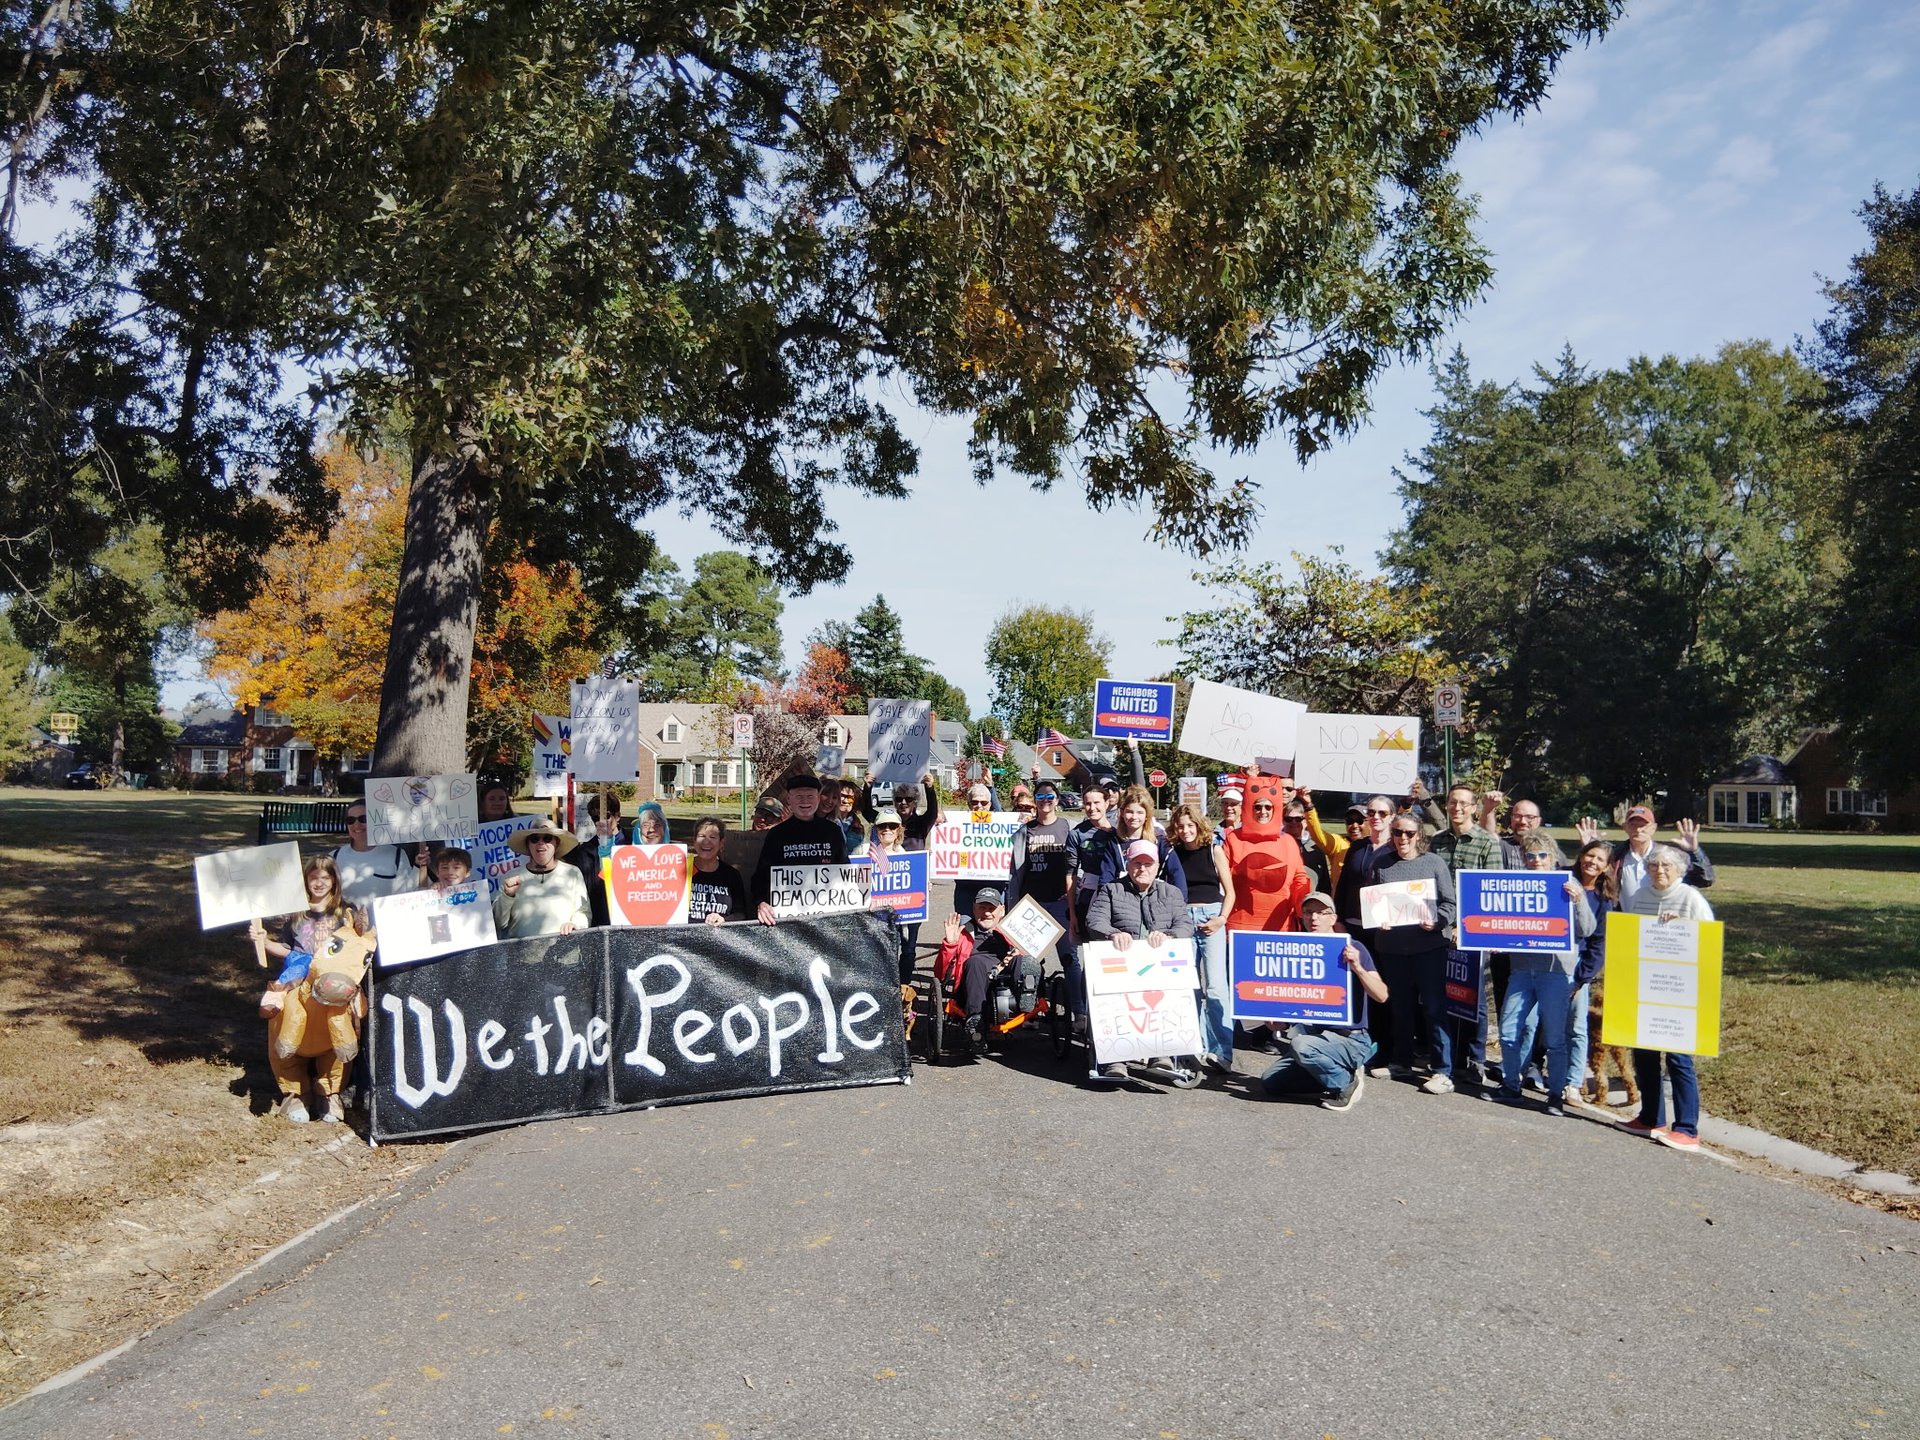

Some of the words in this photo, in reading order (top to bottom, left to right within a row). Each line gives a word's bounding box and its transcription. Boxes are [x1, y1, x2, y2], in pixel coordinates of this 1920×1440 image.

[1112, 686, 1158, 698] NEIGHBORS
[876, 705, 904, 719] SAVE
[1111, 696, 1158, 713] UNITED
[1117, 716, 1157, 726] DEMOCRACY
[1221, 700, 1253, 730] NO
[871, 722, 927, 736] DEMOCRACY
[889, 740, 904, 750] NO
[1207, 727, 1278, 764] KINGS
[1319, 725, 1359, 750] NO
[542, 753, 566, 769] THE
[1150, 774, 1166, 783] STOP
[1319, 758, 1409, 785] KINGS
[410, 804, 468, 824] SHALL
[936, 827, 961, 844] NO
[1030, 835, 1055, 844] PROUD
[619, 856, 637, 869] WE
[654, 853, 683, 866] LOVE
[783, 850, 832, 858] PATRIOTIC
[935, 851, 960, 869] NO
[627, 869, 678, 882] AMERICA
[772, 868, 804, 887] THIS
[815, 868, 830, 885] IS
[840, 867, 871, 884] WHAT
[644, 882, 662, 890] AND
[1480, 879, 1547, 892] NEIGHBORS
[627, 890, 678, 903] FREEDOM
[710, 893, 716, 902] A
[771, 888, 869, 908] DEMOCRACY
[1480, 892, 1548, 913] UNITED
[1022, 907, 1051, 934] DEI
[1491, 918, 1550, 931] DEMOCRACY
[1255, 941, 1324, 957] NEIGHBORS
[1254, 955, 1325, 980] UNITED
[1265, 985, 1326, 999] DEMOCRACY
[382, 994, 514, 1109] We
[524, 996, 609, 1075] the
[624, 954, 885, 1077] People
[1113, 1030, 1177, 1057] ONE
